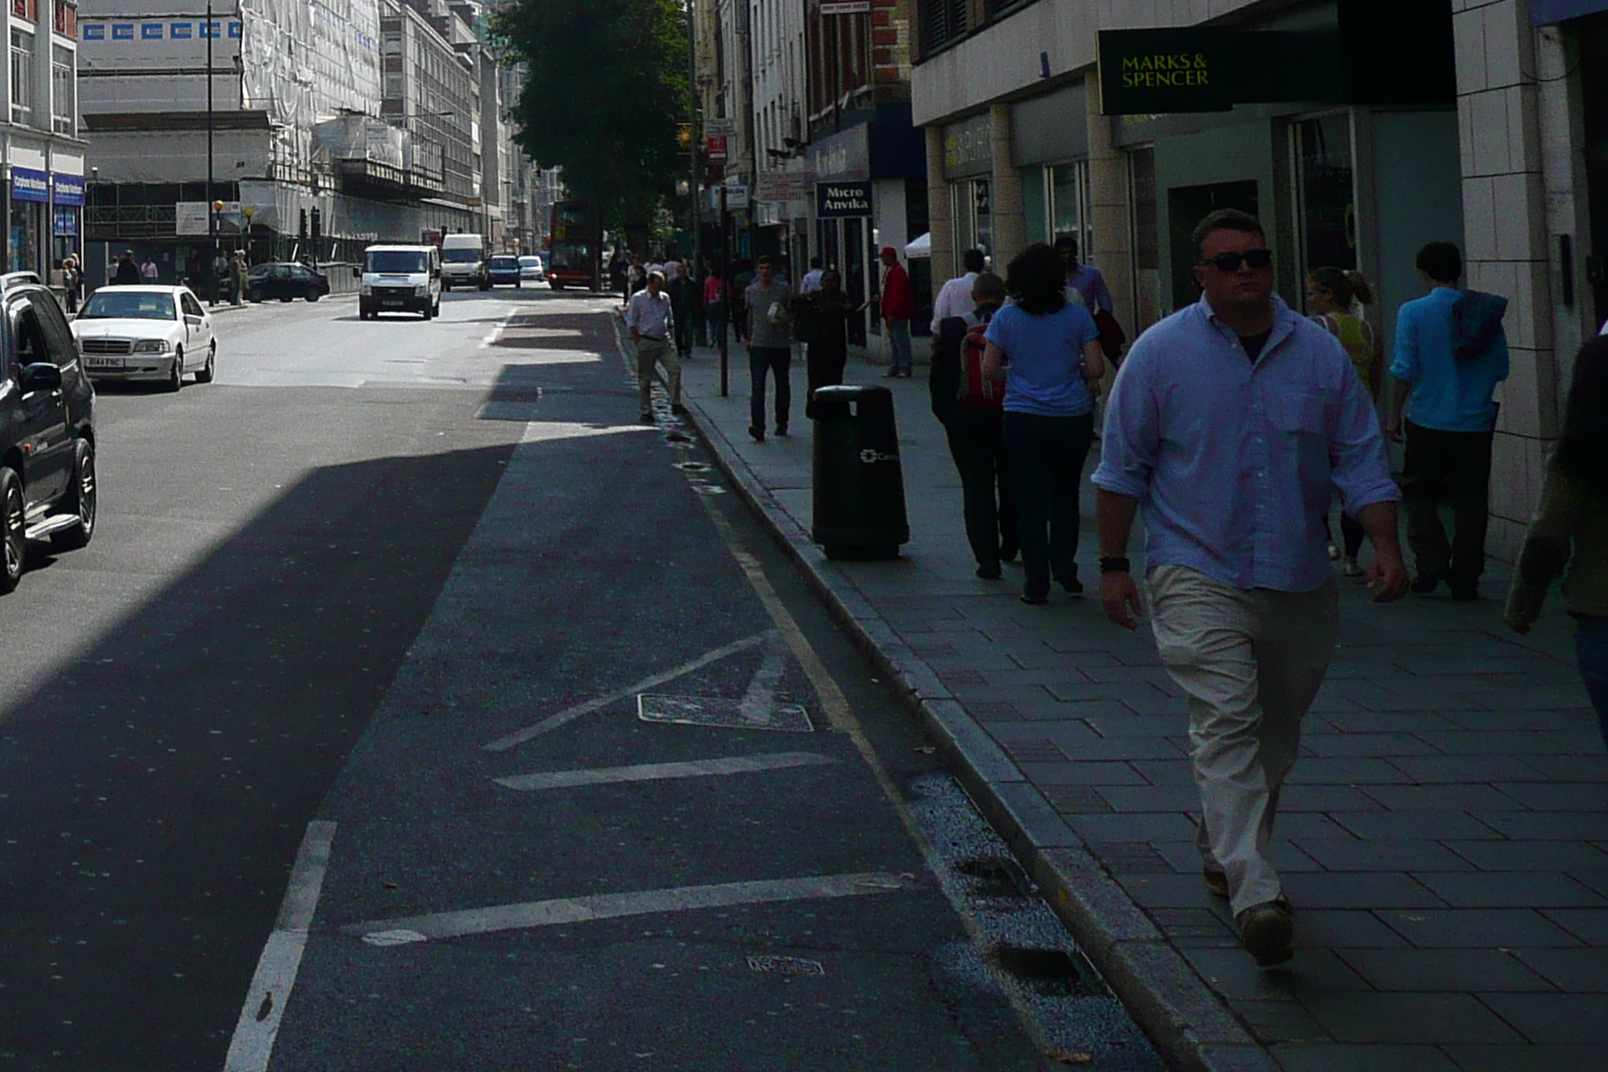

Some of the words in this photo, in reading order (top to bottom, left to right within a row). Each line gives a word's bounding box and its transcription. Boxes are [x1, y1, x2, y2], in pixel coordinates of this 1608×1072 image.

[1122, 53, 1191, 70] MARKS
[1122, 69, 1210, 88] SPENCER
[827, 187, 864, 198] Micro
[824, 199, 869, 211] Anvika
